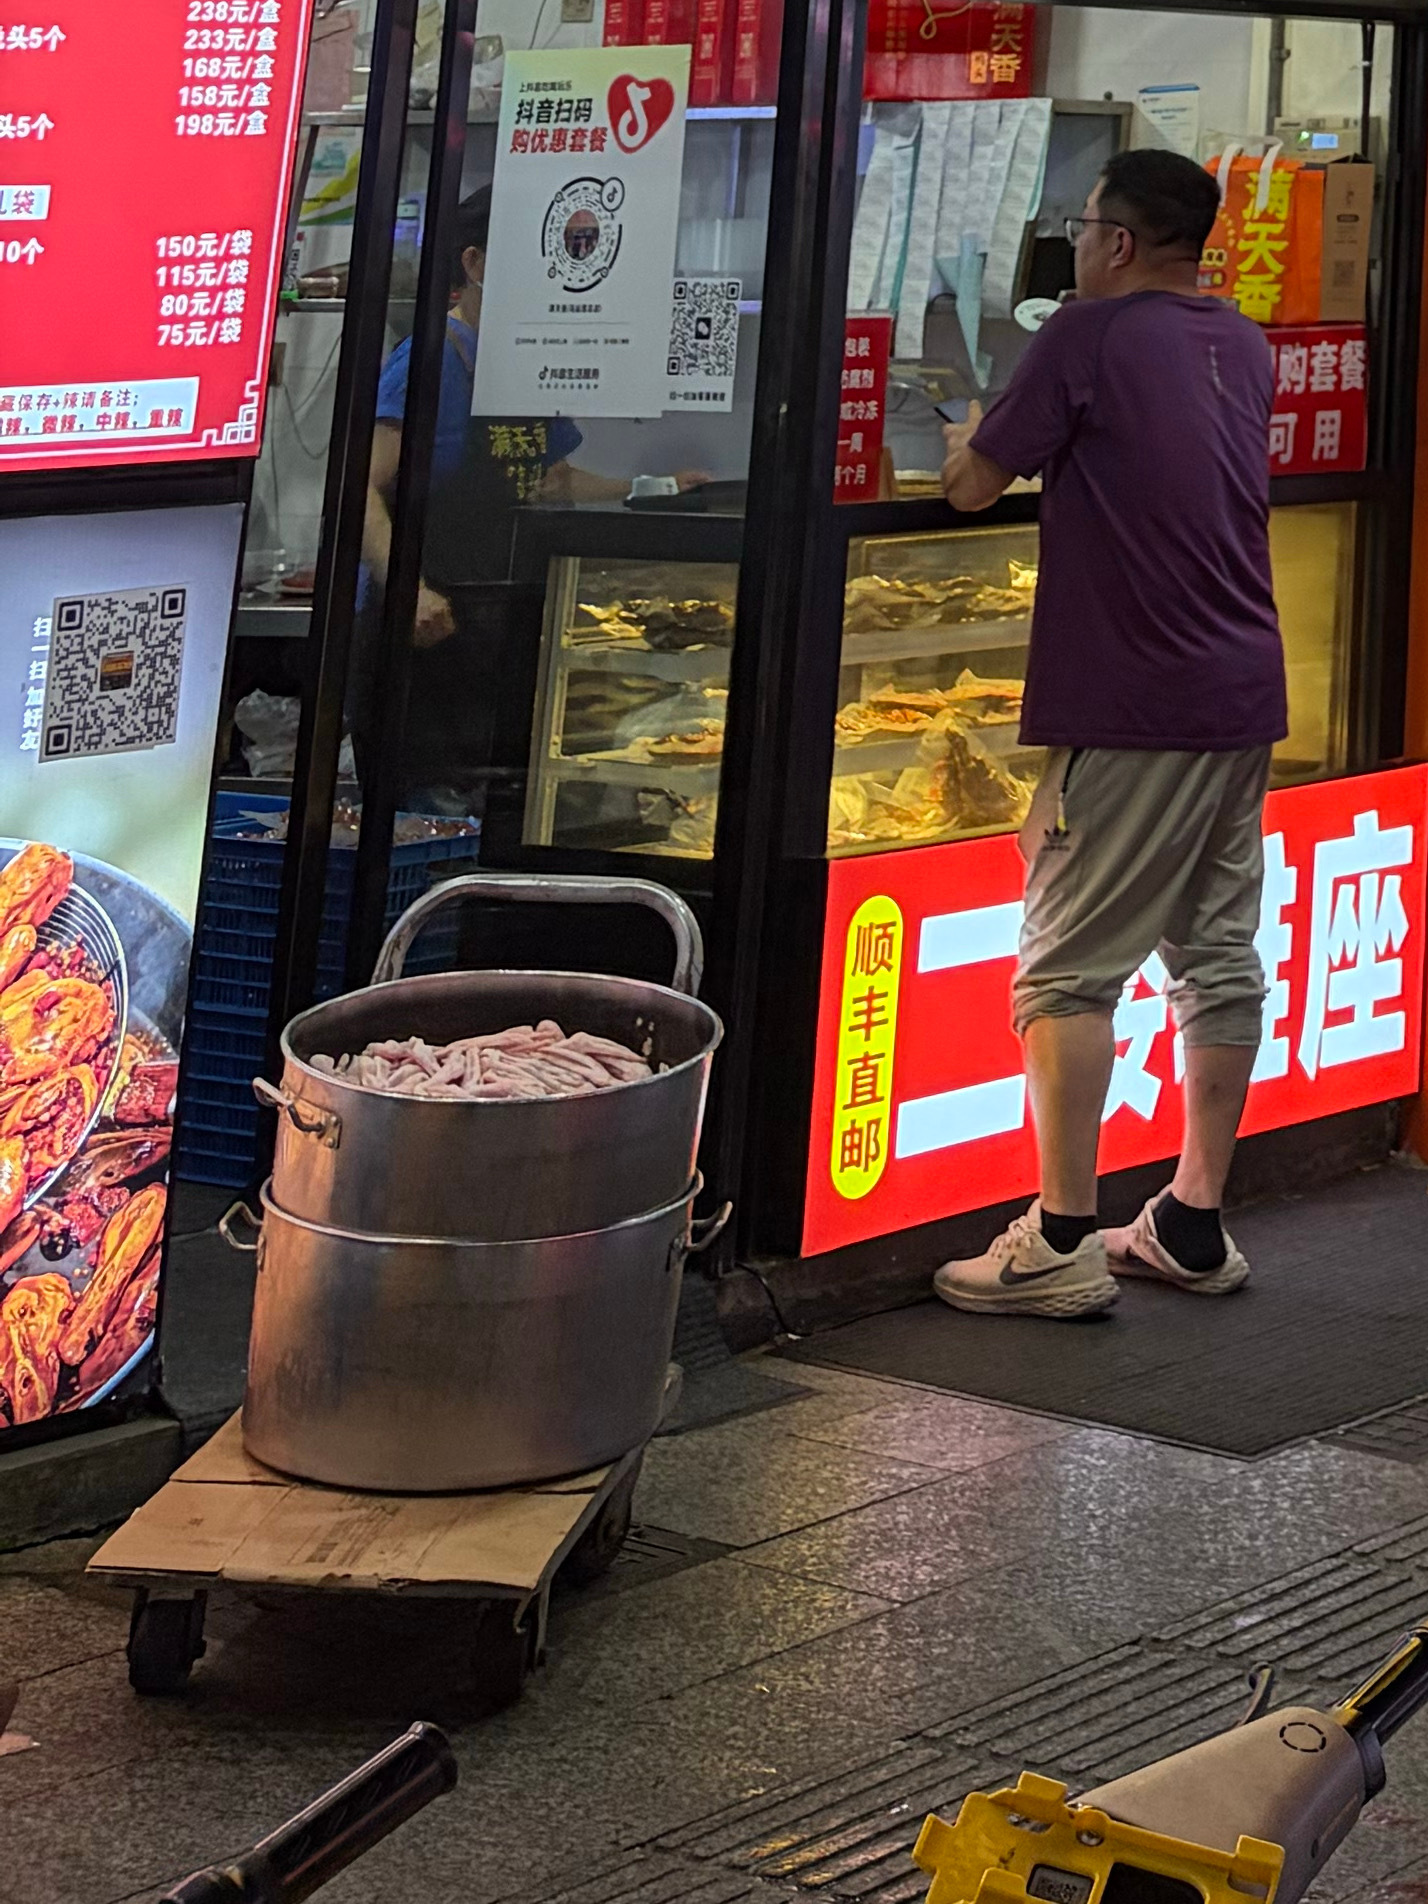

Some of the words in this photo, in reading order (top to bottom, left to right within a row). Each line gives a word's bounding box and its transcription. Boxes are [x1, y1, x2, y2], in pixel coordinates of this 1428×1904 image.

[0, 24, 67, 52] 头5个
[183, 26, 278, 52] 233元/盒
[182, 53, 276, 80] 168元/盒
[178, 81, 272, 108] 158元/盒
[174, 109, 268, 137] 198元/盒
[514, 96, 594, 126] 抖音扫码
[509, 126, 609, 155] 购优惠套餐
[0, 189, 36, 216] 袋
[155, 228, 253, 259] 150元/袋
[1232, 169, 1296, 324] 满天香
[155, 258, 250, 288] 115元/袋
[159, 286, 247, 318] 80元/袋
[156, 316, 243, 348] 75元/袋
[1271, 339, 1367, 395] 购套餐
[896, 809, 1416, 1162] 二座
[835, 917, 902, 1174] 顺丰直邮
